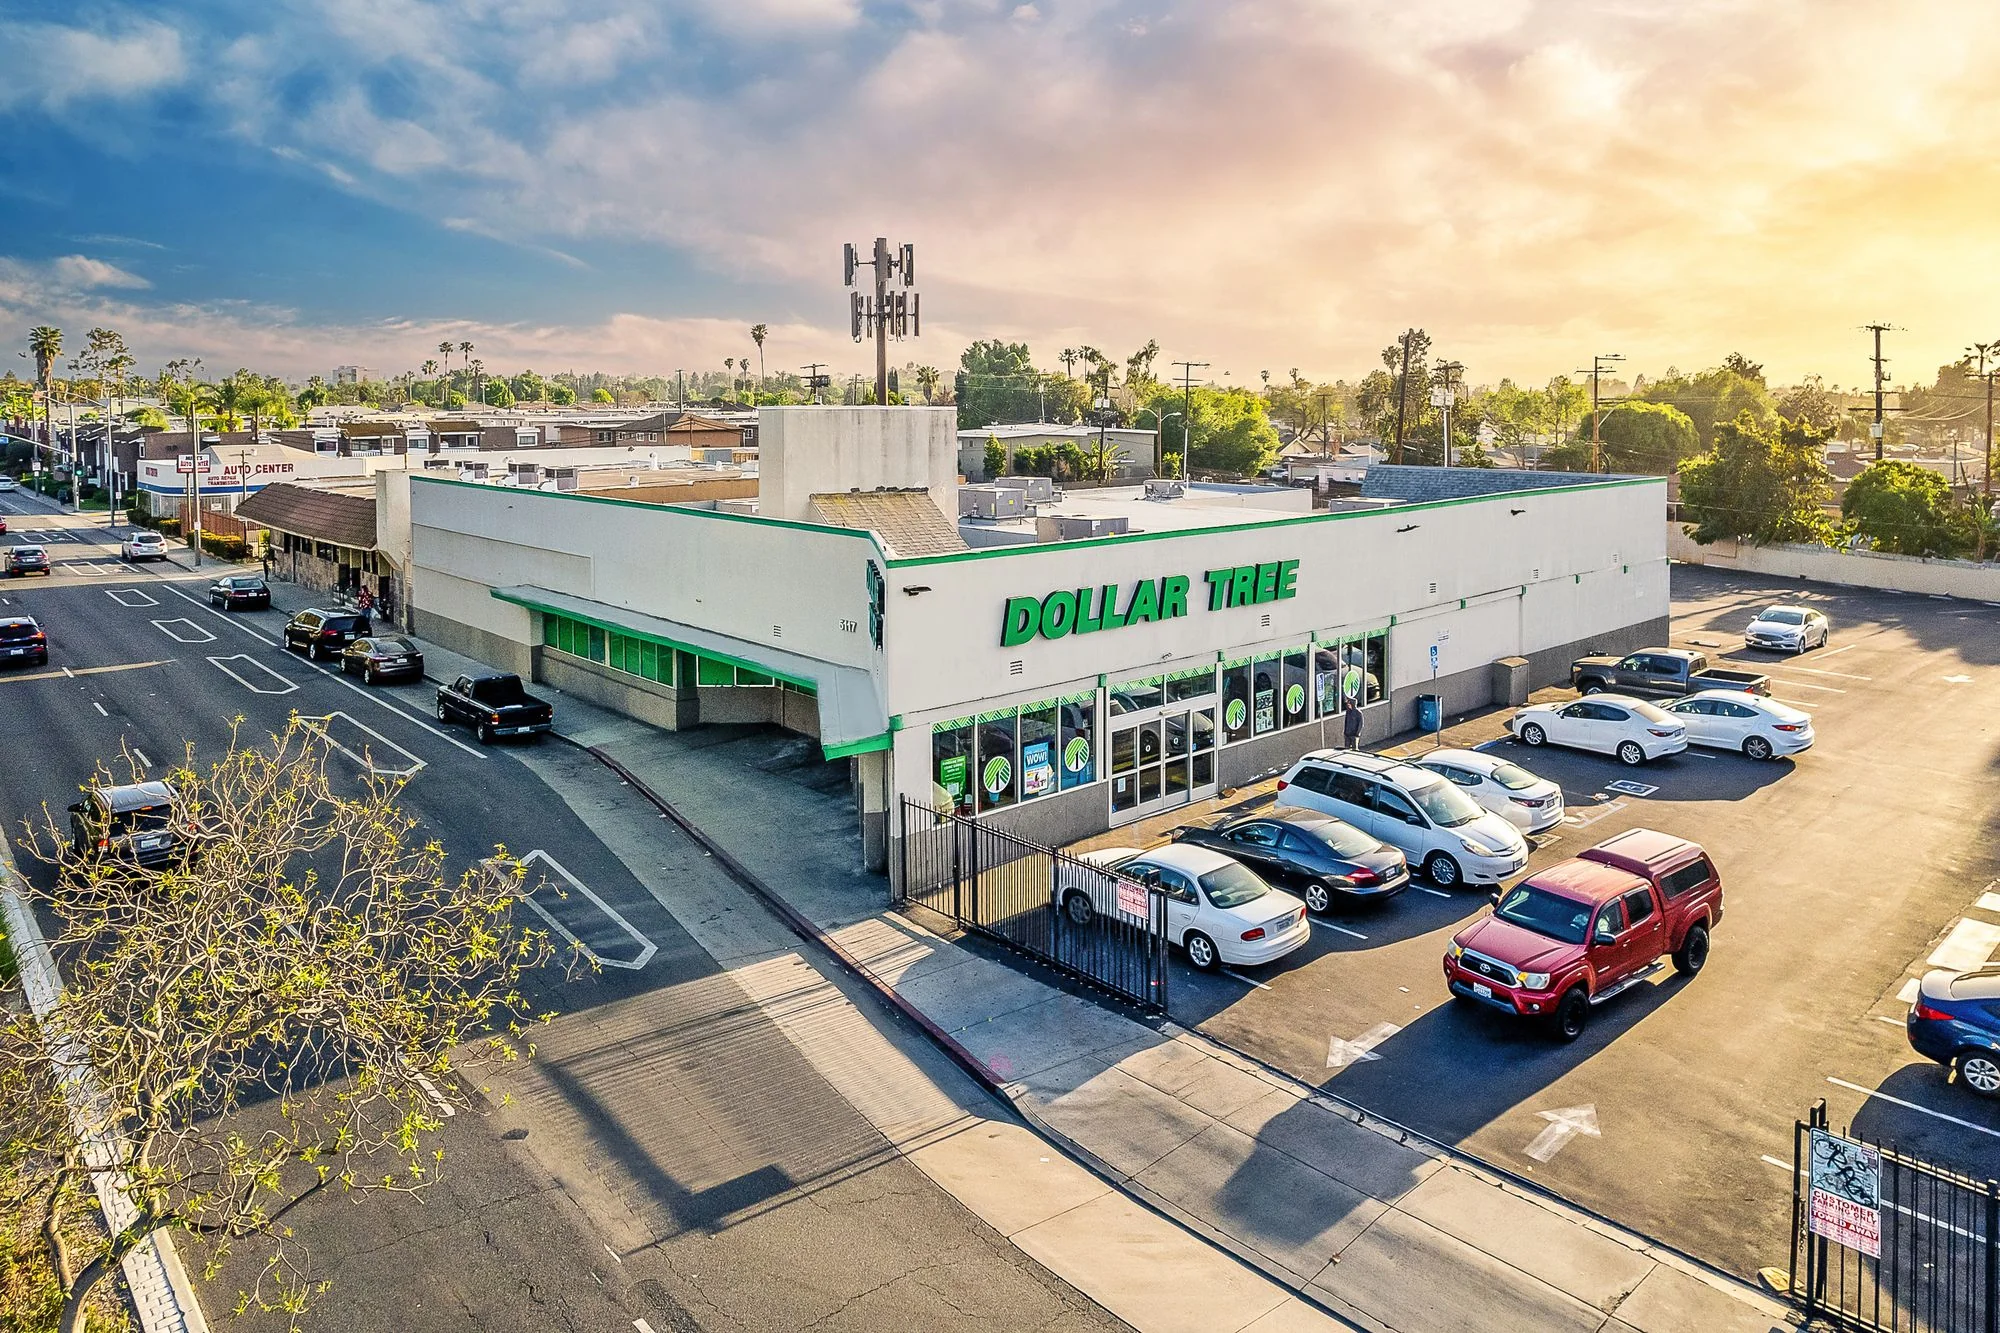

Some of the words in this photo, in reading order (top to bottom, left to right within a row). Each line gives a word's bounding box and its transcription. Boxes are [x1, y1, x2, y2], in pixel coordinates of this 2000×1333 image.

[224, 465, 251, 475] AUTO
[255, 463, 294, 473] CENTER
[1000, 574, 1190, 647] DOLLAR
[1205, 559, 1300, 611] TREE
[1812, 1195, 1851, 1215] PARKING
[1853, 1212, 1877, 1225] ONLY
[1813, 1190, 1875, 1219] CUSTOMER
[1812, 1210, 1847, 1228] TOWED
[1848, 1222, 1878, 1240] AWAY
